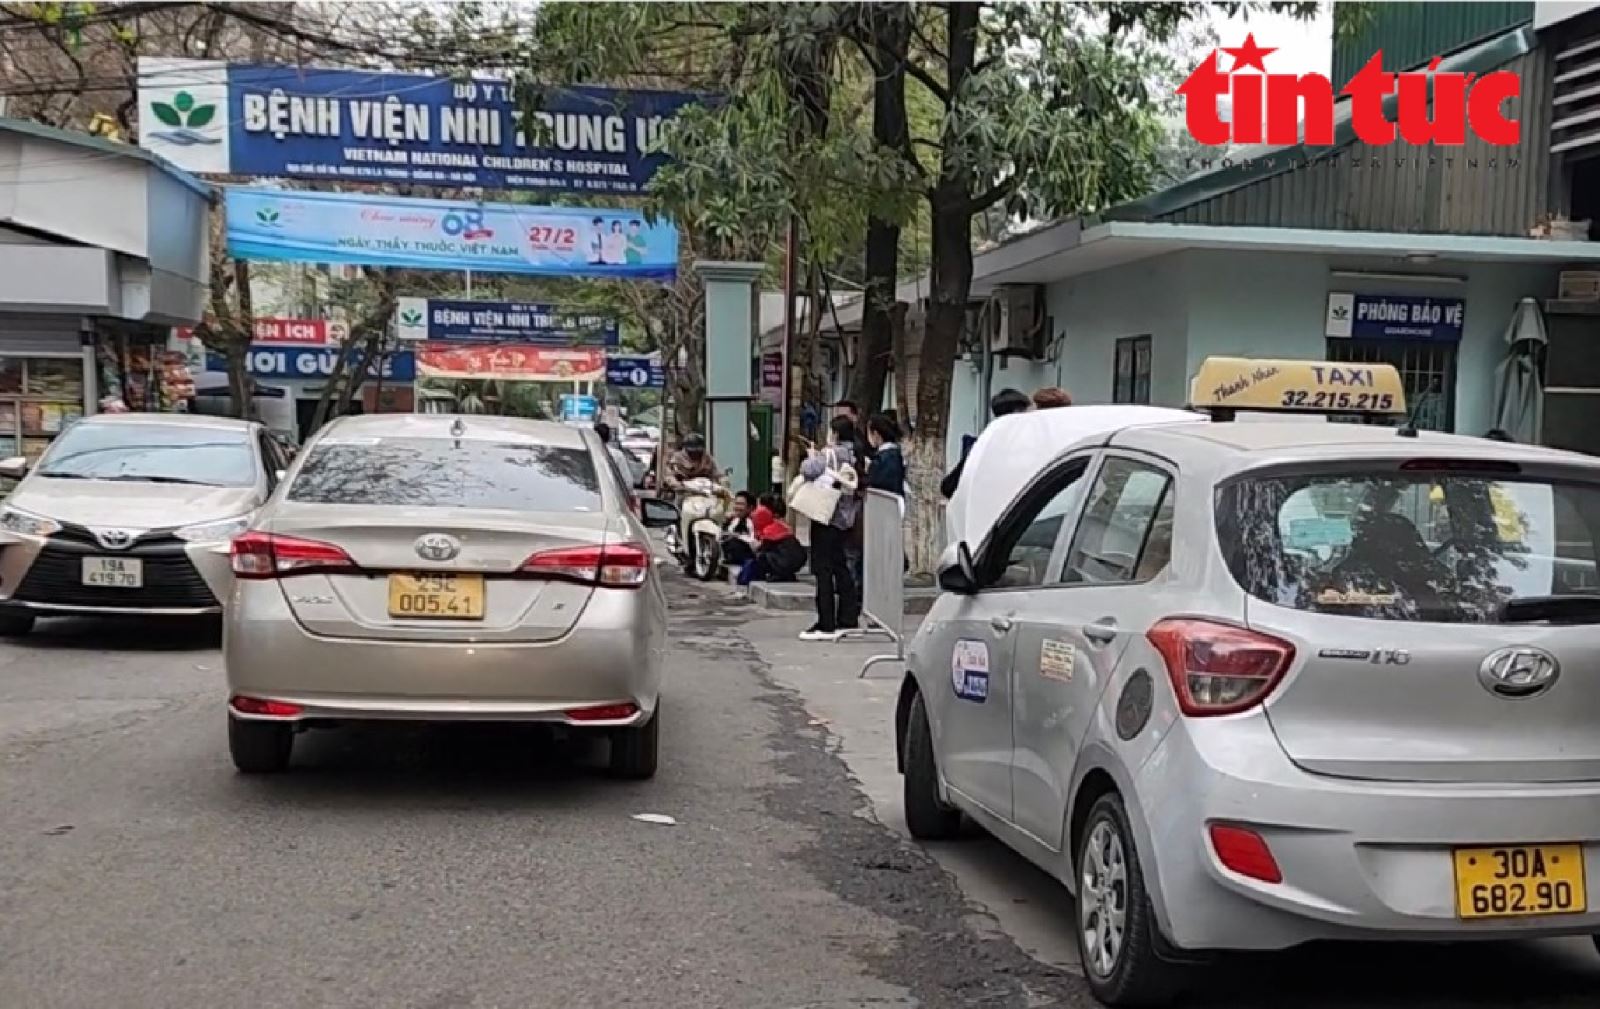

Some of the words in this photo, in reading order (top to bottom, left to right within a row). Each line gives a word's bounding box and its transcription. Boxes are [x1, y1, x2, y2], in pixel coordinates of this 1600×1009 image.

[483, 84, 494, 101] Y
[244, 88, 341, 140] BỆNH
[350, 96, 430, 146] VIỆN
[441, 105, 501, 146] NHI
[344, 147, 408, 163] VIETNAM
[411, 151, 479, 168] NATIONAL
[566, 160, 629, 176] HOSPITAL
[529, 226, 575, 244] 27/2
[1312, 366, 1374, 387] TAXI
[1282, 390, 1393, 410] 32.215.215
[399, 594, 471, 613] 005.41
[1492, 850, 1546, 878] 30A
[1472, 881, 1572, 913] 682.90
